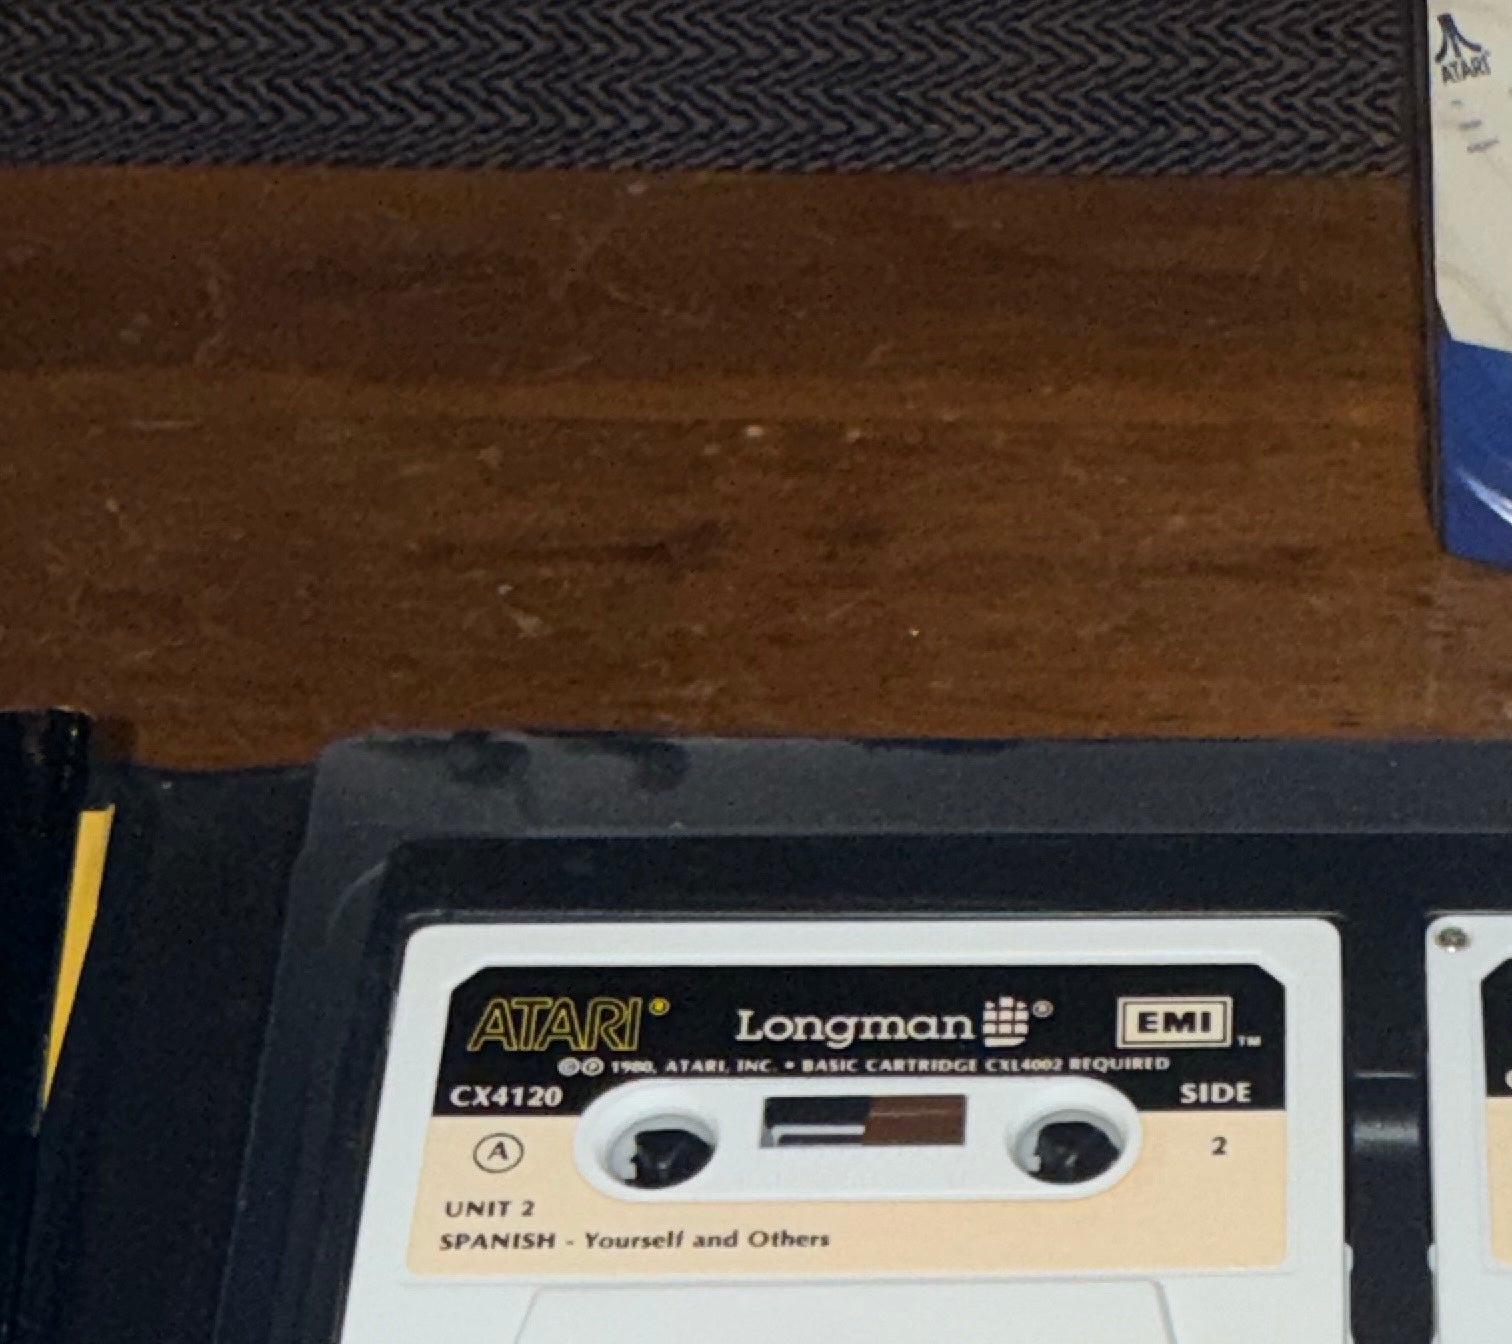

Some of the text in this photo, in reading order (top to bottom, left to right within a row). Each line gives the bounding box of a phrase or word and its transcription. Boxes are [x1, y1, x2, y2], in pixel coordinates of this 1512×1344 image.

[735, 1009, 975, 1049] Longman
[1139, 1011, 1211, 1033] EMI
[803, 1059, 856, 1072] BASIC
[864, 1059, 976, 1071] CARTRIDGE
[1069, 1057, 1169, 1073] REQUIRED
[450, 1085, 563, 1107] CX4120
[1181, 1083, 1250, 1103] SIDE
[1213, 1137, 1227, 1155] 2
[445, 1200, 535, 1217] UNIT 2
[440, 1233, 555, 1249] SPANISH
[585, 1231, 683, 1249] Yourself
[693, 1229, 738, 1247] and
[748, 1230, 829, 1247] Others
